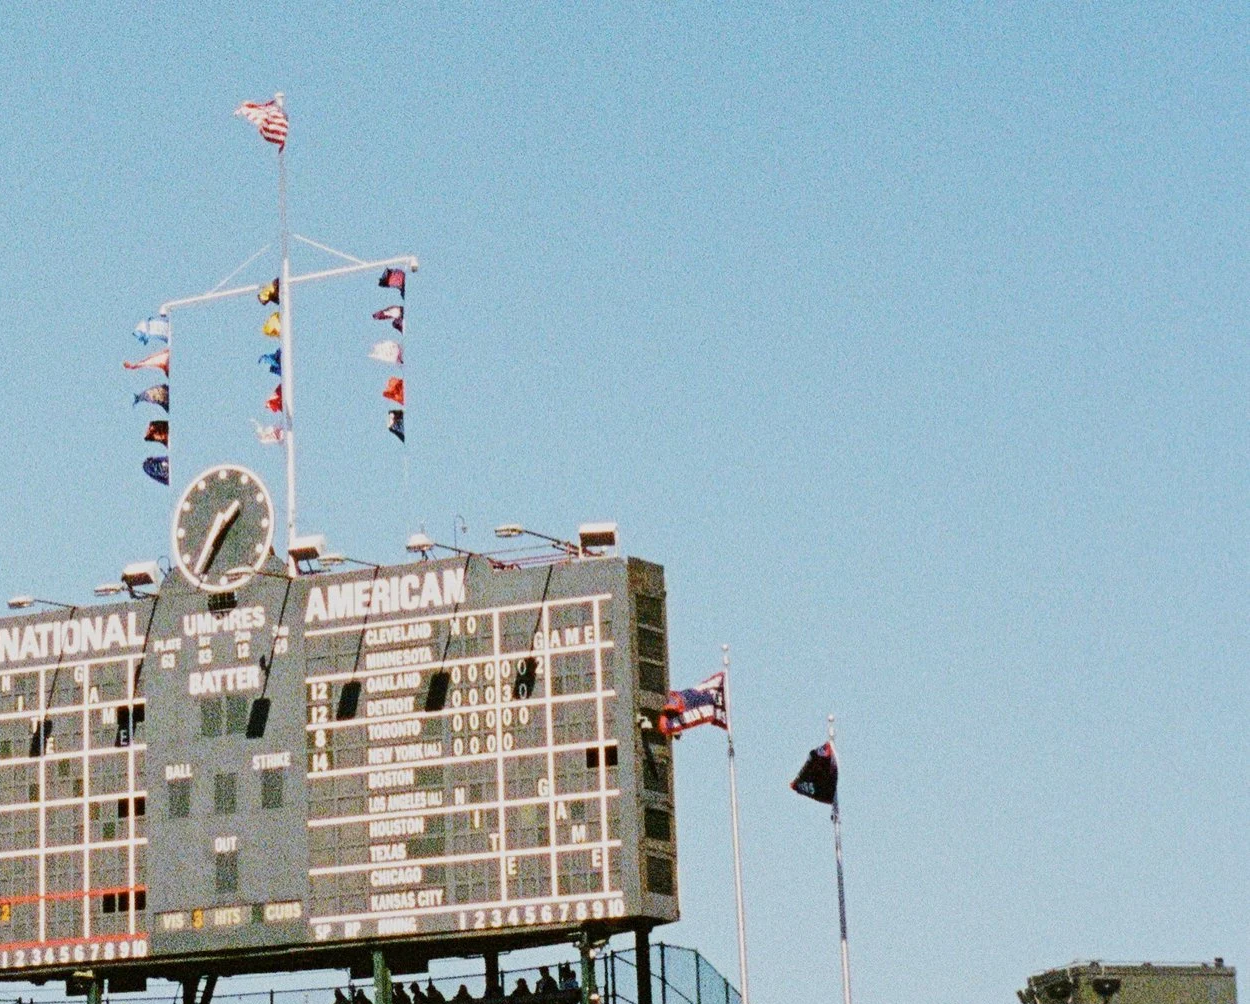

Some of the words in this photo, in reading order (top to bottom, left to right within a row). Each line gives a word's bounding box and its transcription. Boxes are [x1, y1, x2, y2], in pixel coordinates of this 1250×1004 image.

[304, 568, 465, 622] AMERICAN
[183, 606, 265, 637] UMPIRES
[365, 622, 431, 646] CLEVELAND
[366, 646, 432, 670] MINNESOTA
[189, 665, 260, 696] BATTER
[451, 666, 461, 684] 0
[468, 664, 477, 682] 0
[485, 662, 494, 680] 0
[501, 660, 511, 678] 0
[517, 658, 527, 675] 0
[311, 683, 328, 701] 12
[366, 672, 421, 693] OAKLAND
[452, 689, 462, 707] 0
[469, 688, 478, 706] 0
[485, 686, 495, 704] 0
[519, 683, 528, 700] 0
[311, 706, 328, 724] 12
[367, 696, 415, 717] DETROIT
[453, 714, 463, 732] 0
[469, 712, 479, 730] 0
[486, 710, 495, 728] 0
[503, 708, 512, 726] 0
[519, 706, 529, 725] 0
[368, 719, 421, 741] TORONTO
[368, 747, 393, 764] NEW
[394, 743, 423, 762] YORK
[453, 738, 463, 756] 0
[470, 736, 480, 754] 0
[486, 734, 496, 752] 0
[503, 732, 513, 751] 0
[252, 751, 292, 770] STRIKE
[312, 753, 328, 772] 14
[165, 764, 193, 780] BALL
[368, 768, 415, 789] BOSTON
[387, 791, 427, 812] ANGELES
[370, 817, 424, 838] HOUSTON
[214, 835, 238, 852] OUT
[370, 842, 407, 862] TEXAS
[371, 866, 422, 887] CHICAGO
[371, 890, 416, 912] KANSAS
[417, 889, 444, 907] CITY
[163, 912, 184, 929] VIS
[214, 907, 241, 925] HITS
[265, 902, 302, 921] CUBS
[459, 912, 467, 930] 1
[474, 911, 485, 929] 2
[491, 909, 502, 928] 3
[507, 907, 519, 926] 4
[525, 905, 536, 924] 5
[541, 904, 552, 923] 6
[559, 903, 569, 922] 7
[576, 901, 587, 920] 8
[593, 900, 604, 919] 9
[2, 951, 8, 968] 1
[15, 950, 26, 967] 2
[31, 948, 42, 966] 3
[44, 947, 55, 964] 4
[59, 945, 70, 963] 5
[74, 944, 85, 962] 6
[90, 943, 100, 961] 7
[104, 942, 115, 960] 8
[119, 941, 130, 958] 9
